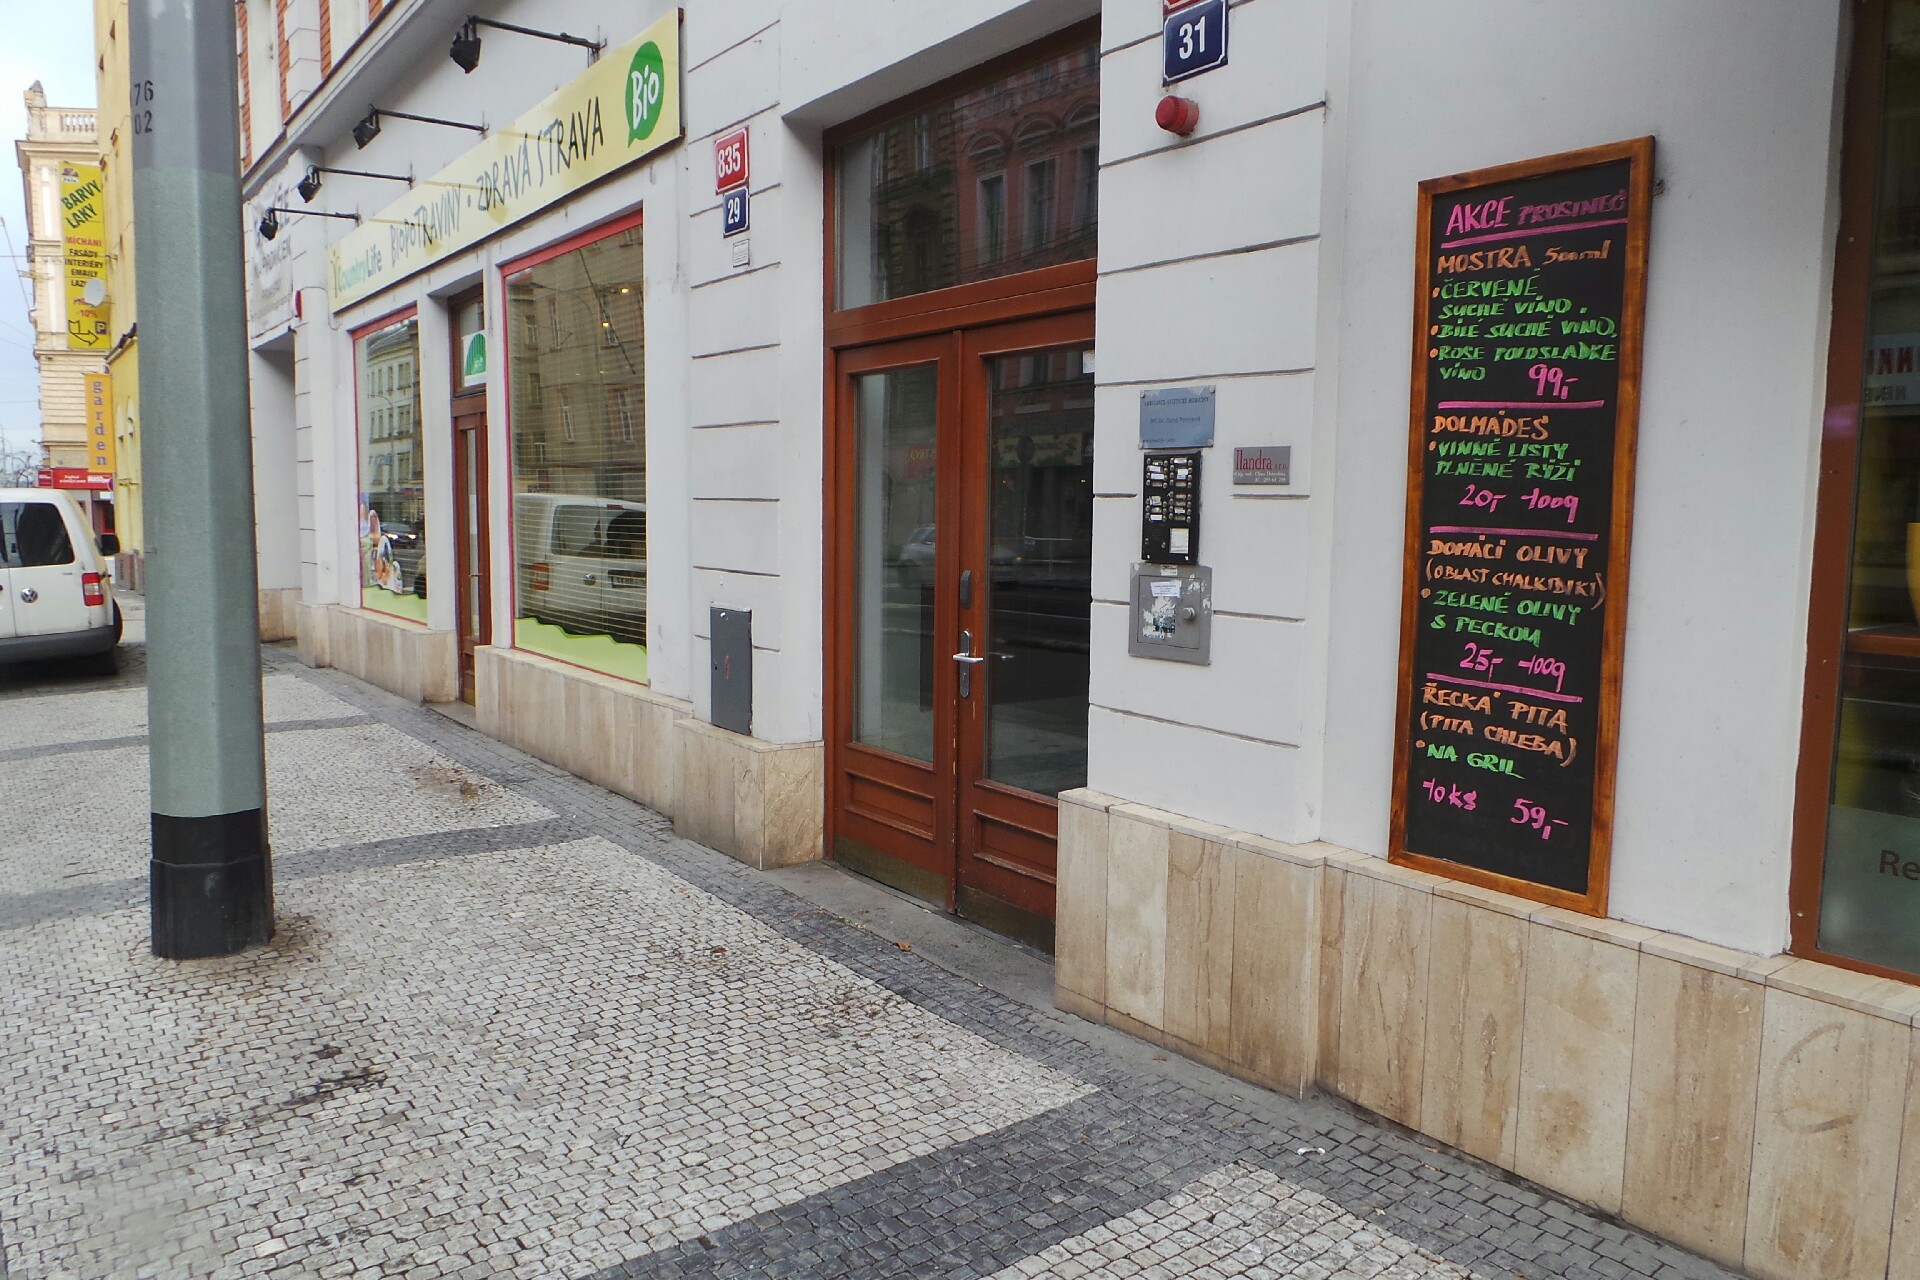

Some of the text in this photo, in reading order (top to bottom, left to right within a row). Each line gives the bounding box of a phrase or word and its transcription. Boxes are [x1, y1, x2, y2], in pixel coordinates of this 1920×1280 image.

[1178, 15, 1206, 60] 31
[134, 79, 154, 106] 76
[476, 131, 532, 212] ZDRAVÁ
[536, 95, 604, 188] STRAVA
[717, 142, 741, 178] 835
[61, 179, 101, 210] BARVY
[65, 203, 97, 229] LAKY
[727, 197, 741, 225] 29
[1445, 195, 1514, 236] AKCE
[1436, 244, 1533, 275] MOSTRA
[93, 381, 107, 466] garden
[1507, 442, 1569, 460] LISTY
[1516, 545, 1589, 569] OLIVY
[1516, 599, 1582, 626] OLIVY
[1430, 614, 1543, 648] S PECKOU
[1419, 710, 1475, 736] (PITA
[1507, 701, 1569, 735] PITA
[1426, 743, 1526, 780] NA GRIL
